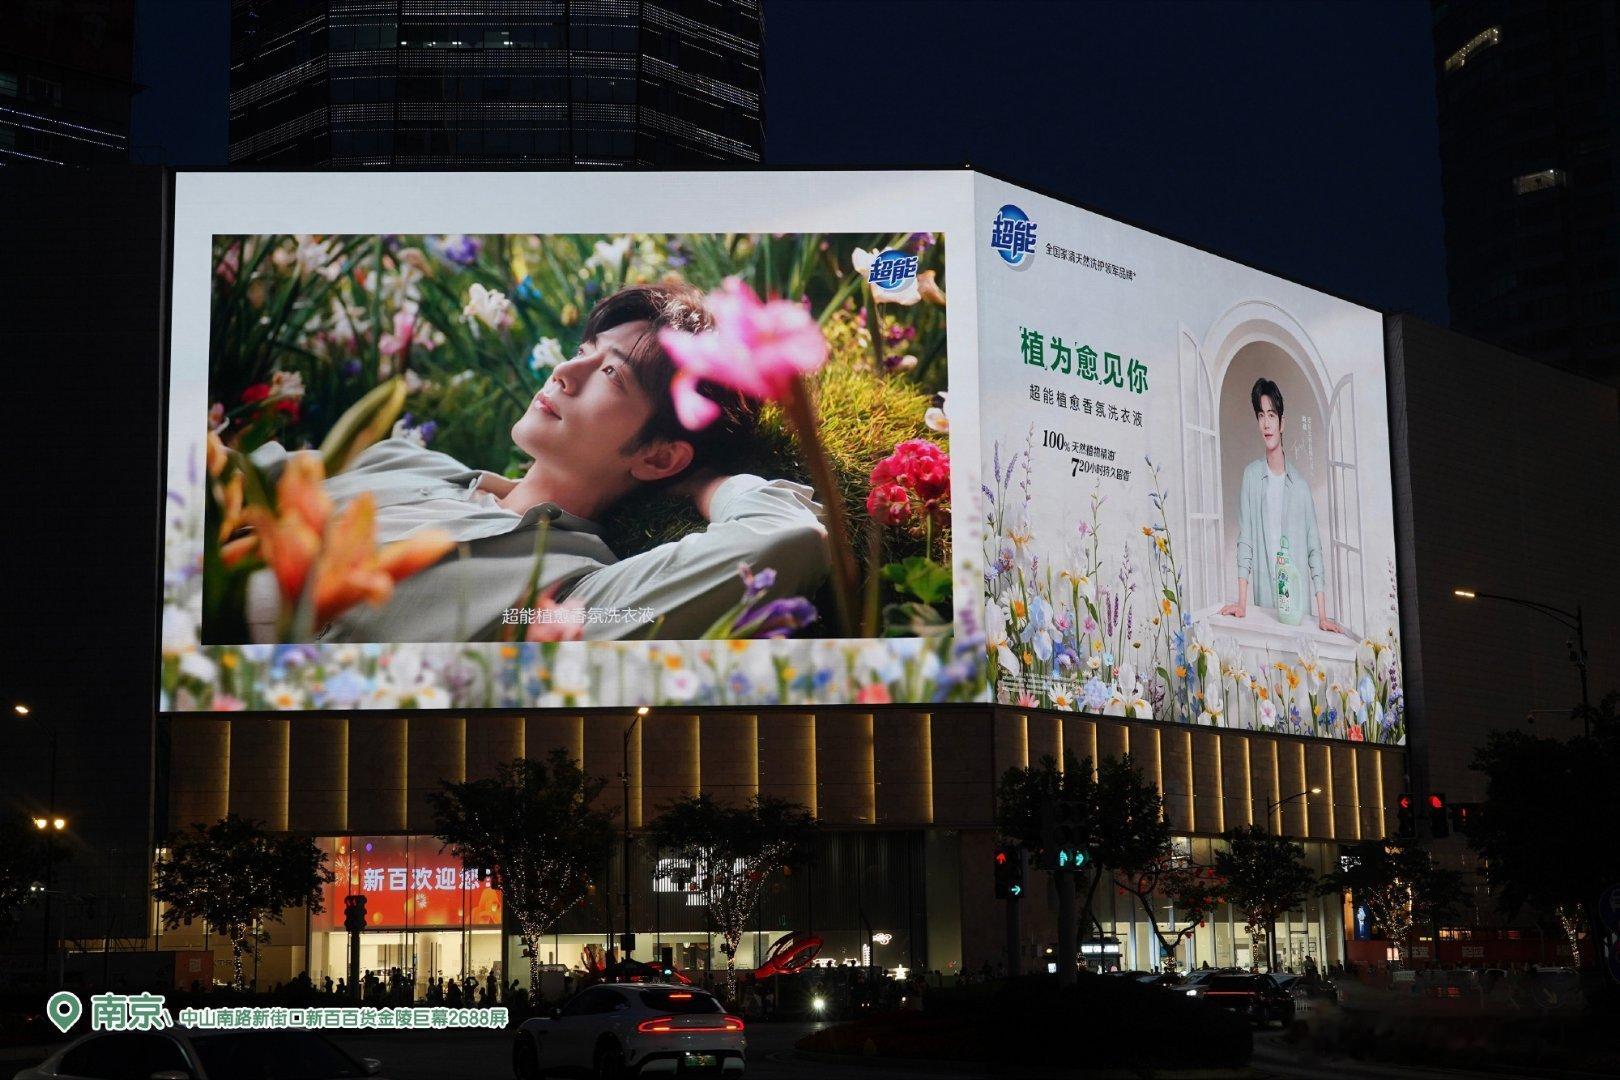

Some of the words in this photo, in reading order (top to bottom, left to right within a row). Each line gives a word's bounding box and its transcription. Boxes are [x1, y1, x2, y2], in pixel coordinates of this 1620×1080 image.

[990, 210, 1037, 259] 超能
[868, 256, 918, 285] 超能
[1029, 384, 1143, 428] 超能植愈香氛洗衣液
[501, 607, 655, 625] 超能植愈香氛洗衣液
